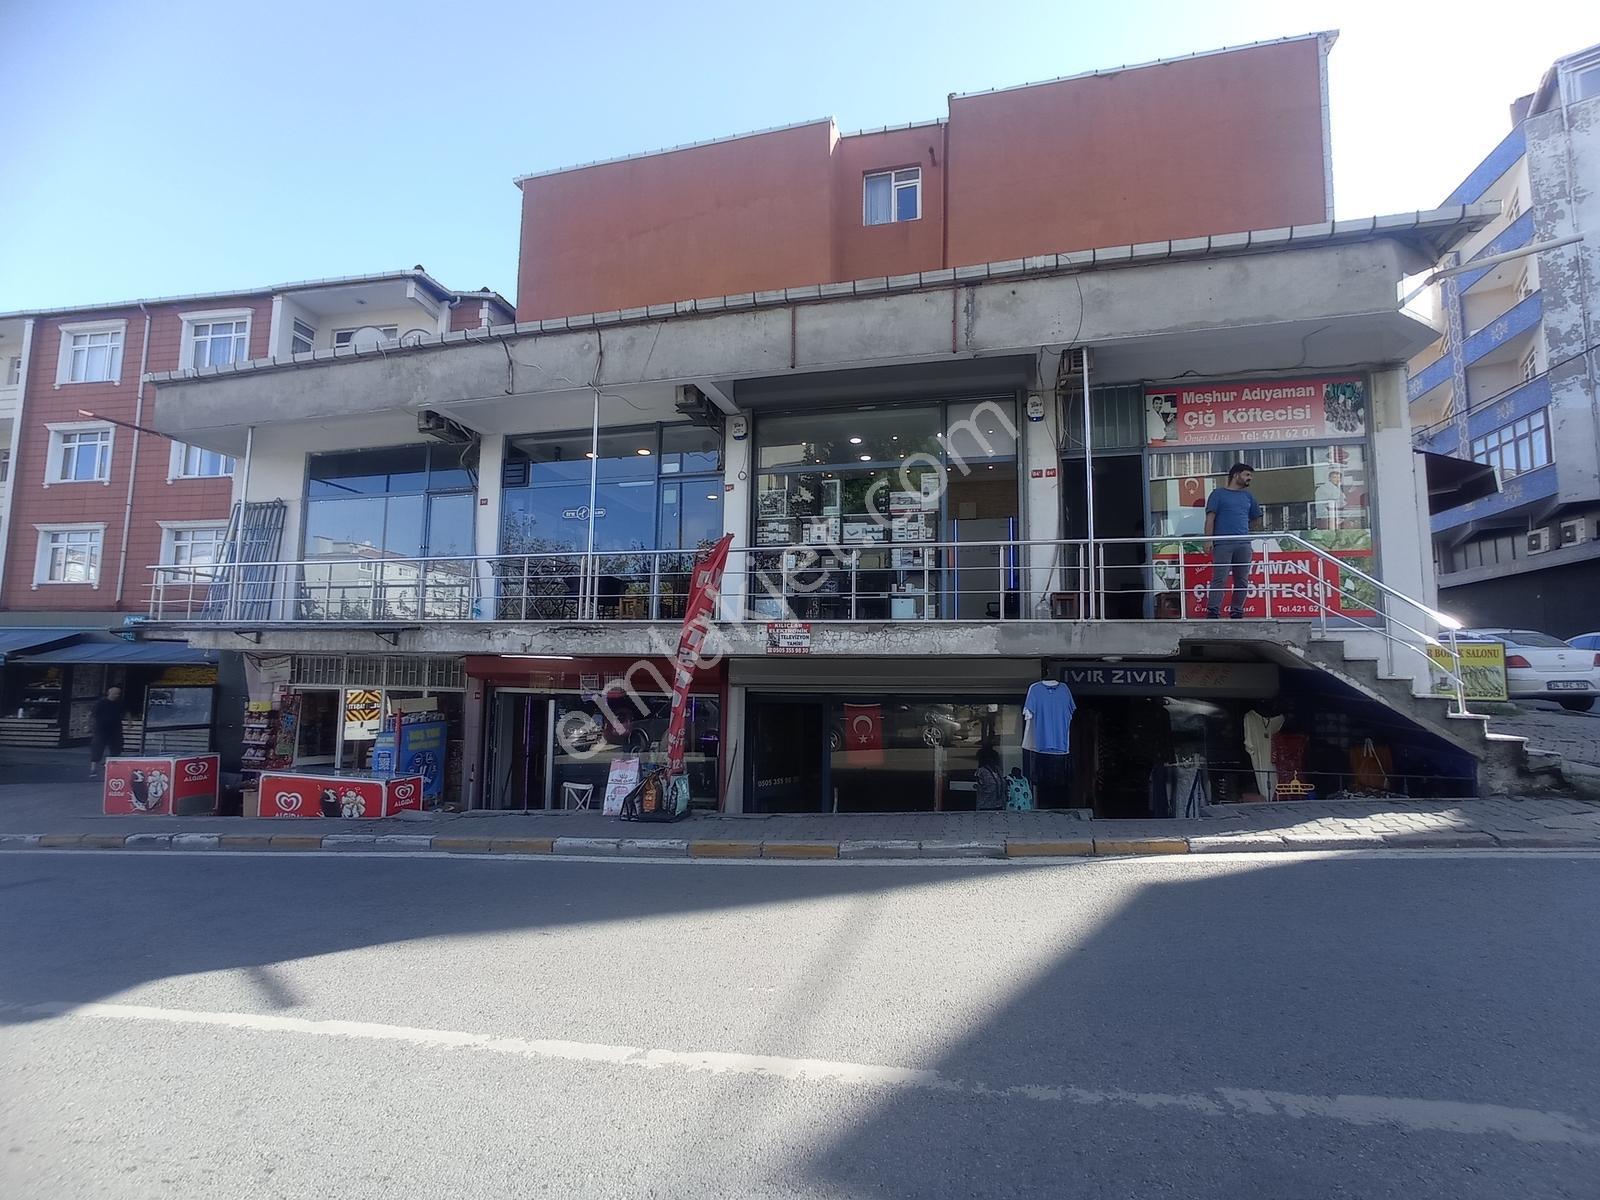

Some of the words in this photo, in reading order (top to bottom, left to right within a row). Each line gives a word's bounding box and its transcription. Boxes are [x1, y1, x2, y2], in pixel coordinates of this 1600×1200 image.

[1182, 390, 1237, 406] Meşhur
[1241, 386, 1315, 402] Adıyaman
[1183, 409, 1216, 429] Çiğ
[1222, 404, 1312, 424] Köftecisi
[1240, 431, 1259, 441] Tel:
[1285, 429, 1297, 438] 62
[1466, 649, 1499, 658] SALONU
[1111, 670, 1167, 685] ZIVIR
[394, 798, 414, 808] ALGIDA
